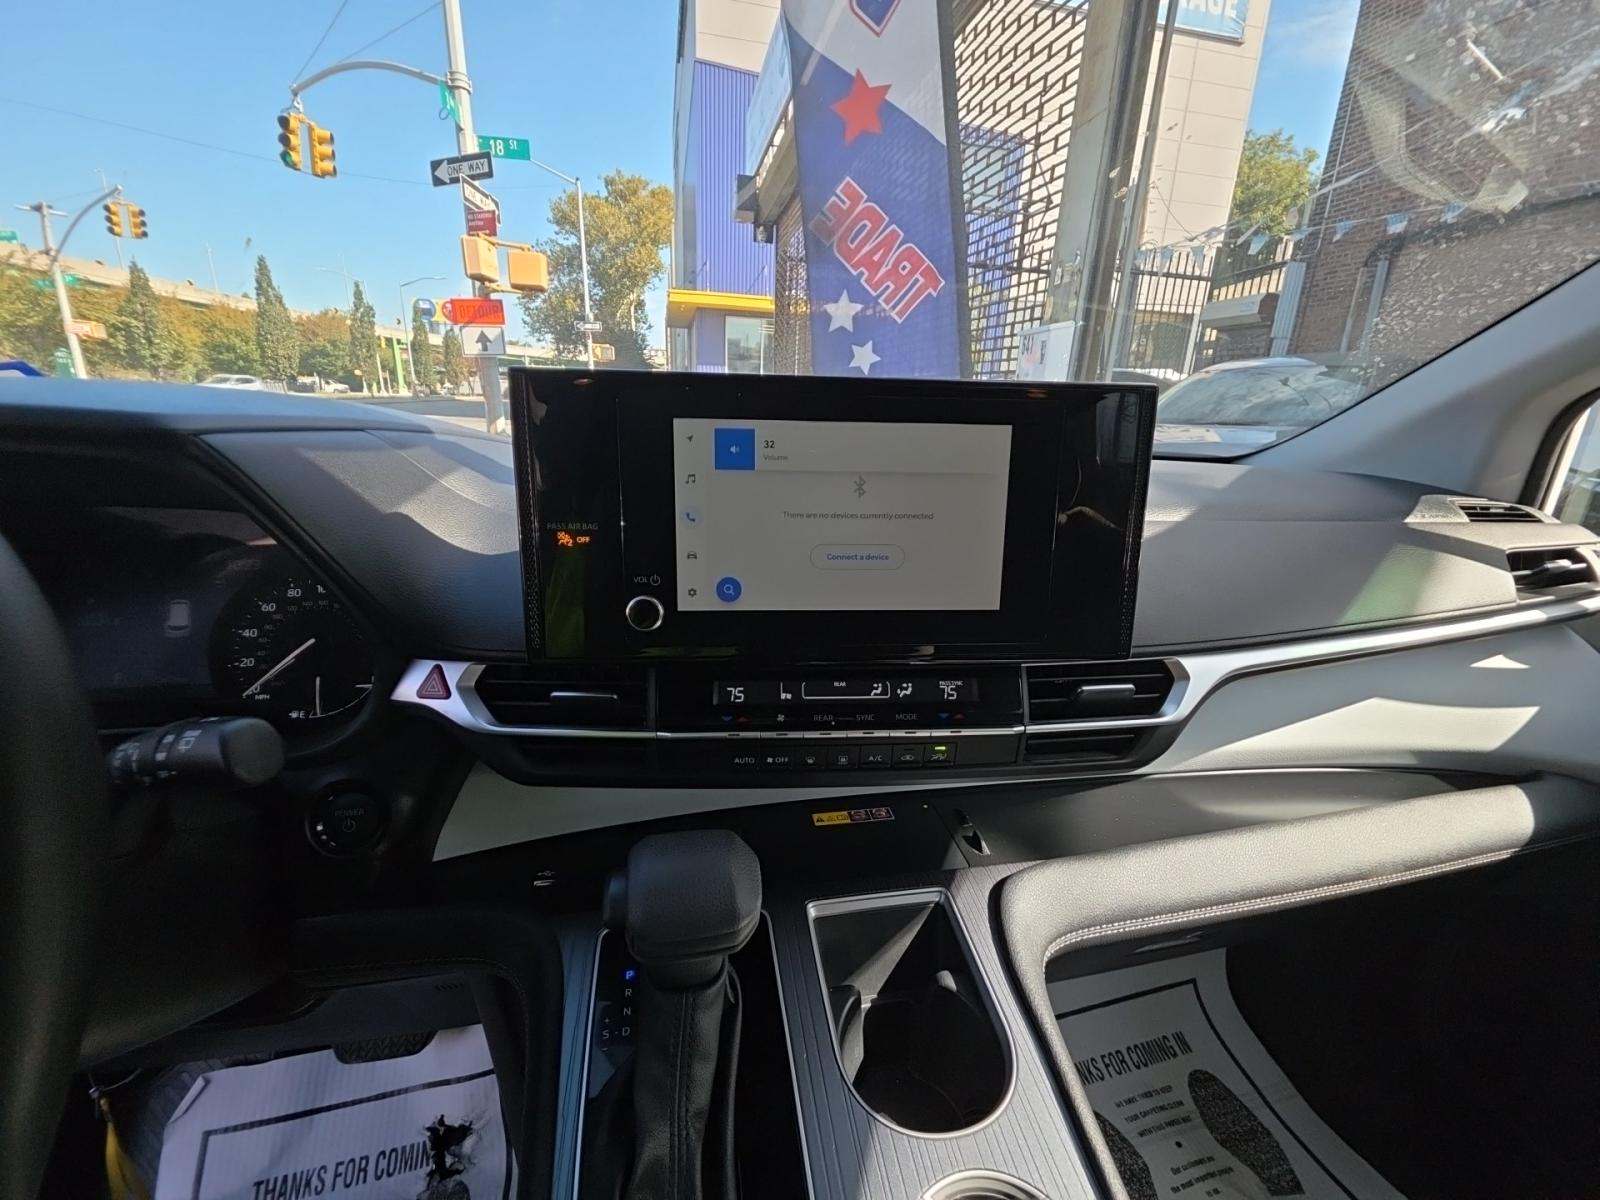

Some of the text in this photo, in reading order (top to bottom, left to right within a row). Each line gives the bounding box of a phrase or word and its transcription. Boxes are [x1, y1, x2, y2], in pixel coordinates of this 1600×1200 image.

[489, 139, 505, 155] 18
[446, 159, 487, 177] ONE WAY
[763, 440, 775, 449] 32
[783, 510, 935, 521] There are no devices currently connected
[576, 535, 590, 543] OFF
[826, 552, 858, 561] Connect
[865, 552, 890, 561] device
[633, 575, 648, 583] VOL
[287, 588, 302, 597] 80
[261, 603, 276, 612] 60
[243, 628, 258, 638] 40
[240, 657, 255, 667] 20
[254, 693, 271, 701] MPH
[726, 686, 745, 703] 75
[939, 685, 957, 700] 75
[813, 713, 833, 721] REAR
[856, 713, 876, 721] SYNC
[896, 713, 919, 721] MODE
[734, 756, 755, 764] AUTO
[625, 969, 634, 980] P
[625, 988, 633, 998] R
[623, 1006, 632, 1016] N
[622, 1026, 631, 1037] D
[1074, 1030, 1193, 1088] NKS FOR COMING IN
[253, 1139, 433, 1200] THANKS FOR COMIN
